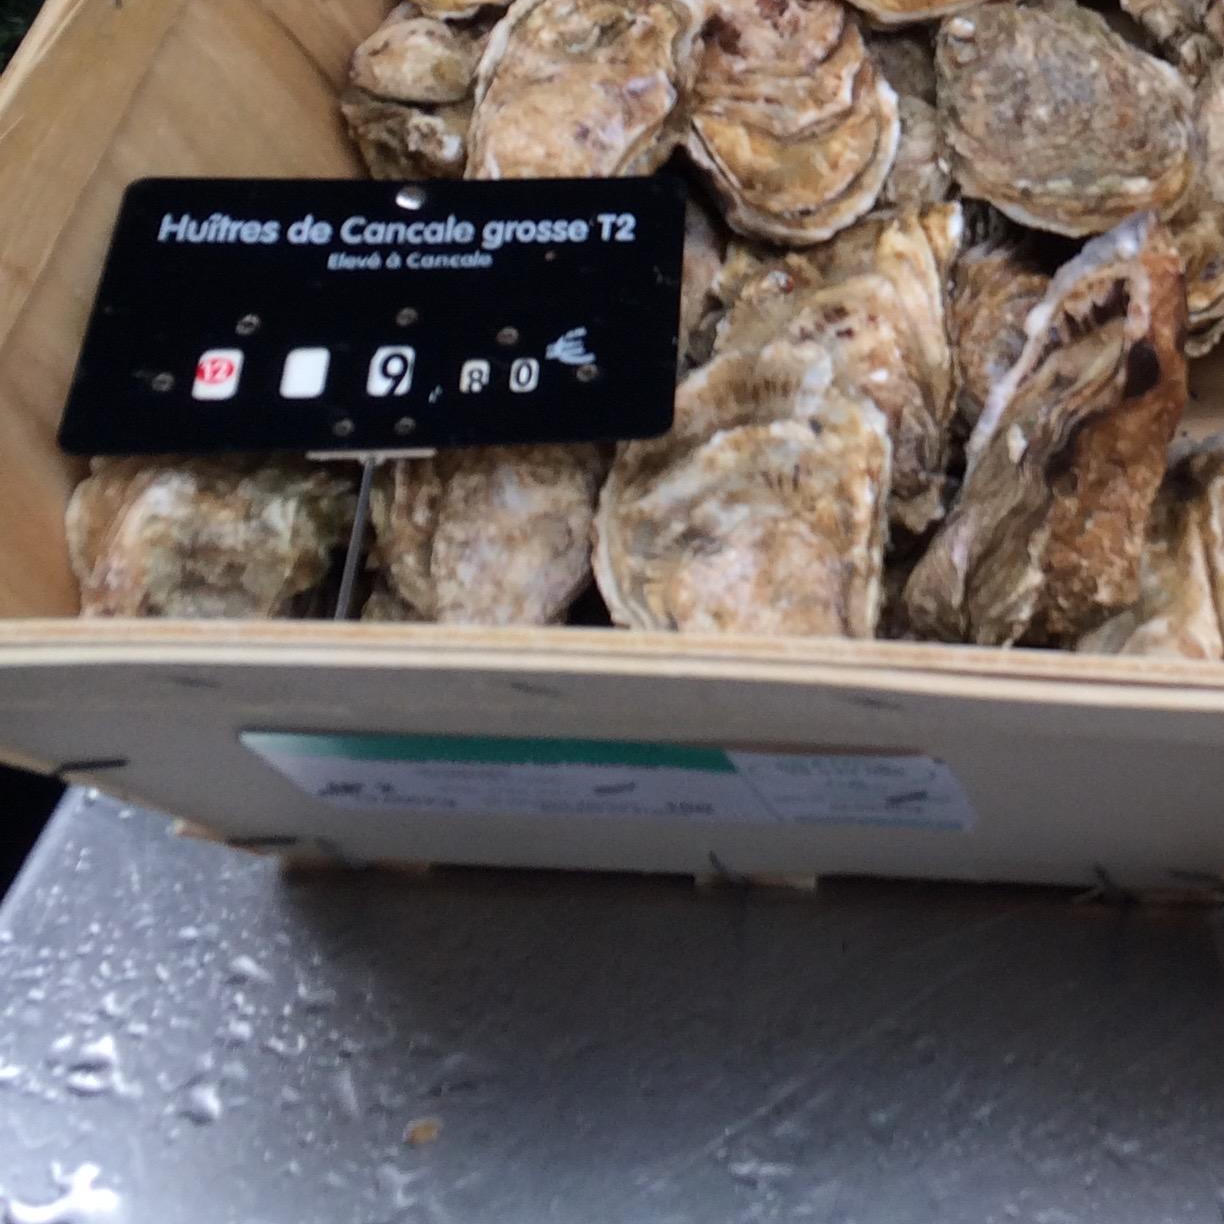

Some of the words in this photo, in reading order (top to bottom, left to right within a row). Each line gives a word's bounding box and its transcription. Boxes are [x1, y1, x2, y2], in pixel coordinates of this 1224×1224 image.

[157, 211, 281, 244] Huîtres
[286, 213, 333, 245] de
[340, 214, 476, 245] Cancale
[481, 218, 590, 250] grosse
[597, 212, 637, 243] T2
[406, 248, 494, 270] Cancale
